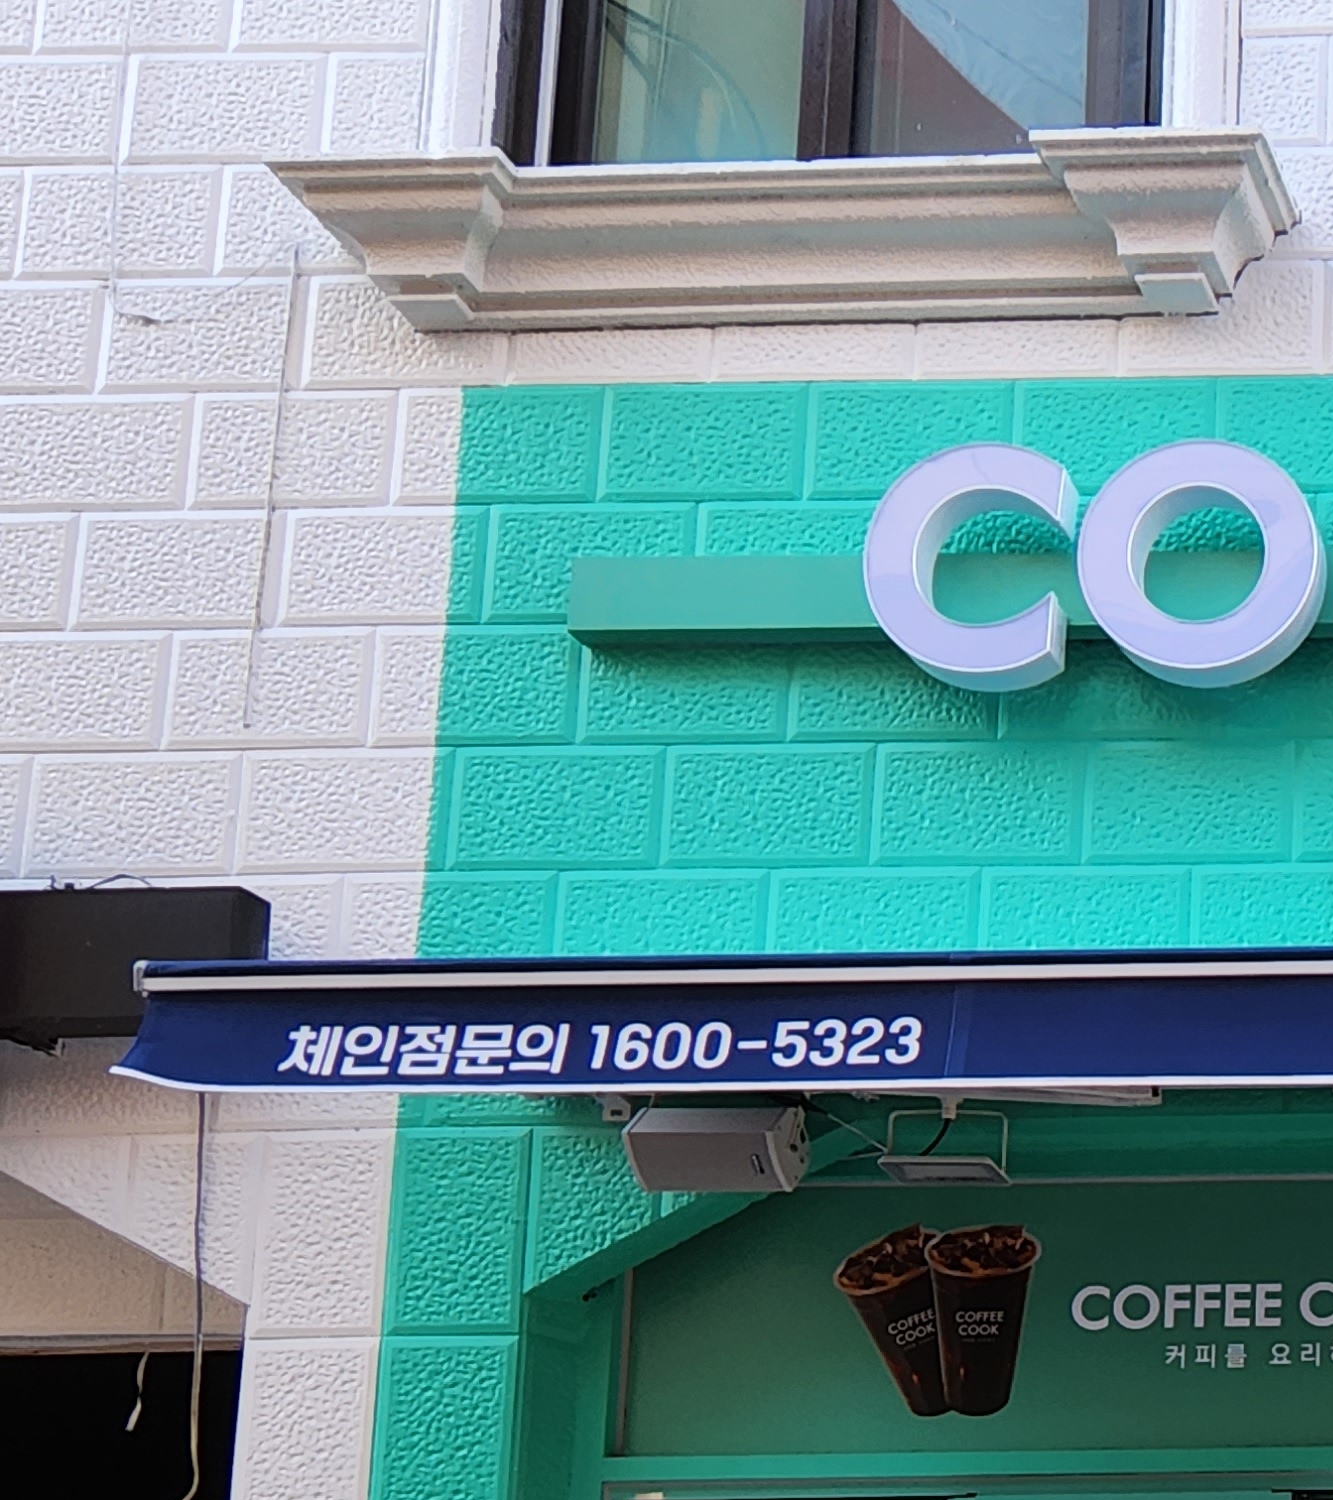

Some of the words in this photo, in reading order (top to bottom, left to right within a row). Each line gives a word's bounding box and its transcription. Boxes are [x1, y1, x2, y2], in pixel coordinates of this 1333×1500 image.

[277, 1021, 570, 1076] 체인점문의
[587, 1015, 924, 1071] 1600-5323
[955, 1311, 1005, 1323] COFFEE
[1071, 1283, 1283, 1332] COFFEE
[887, 1308, 935, 1335] COFFEE
[895, 1322, 936, 1346] COOK
[958, 1324, 999, 1336] COOK
[1164, 1344, 1248, 1369] 커피를
